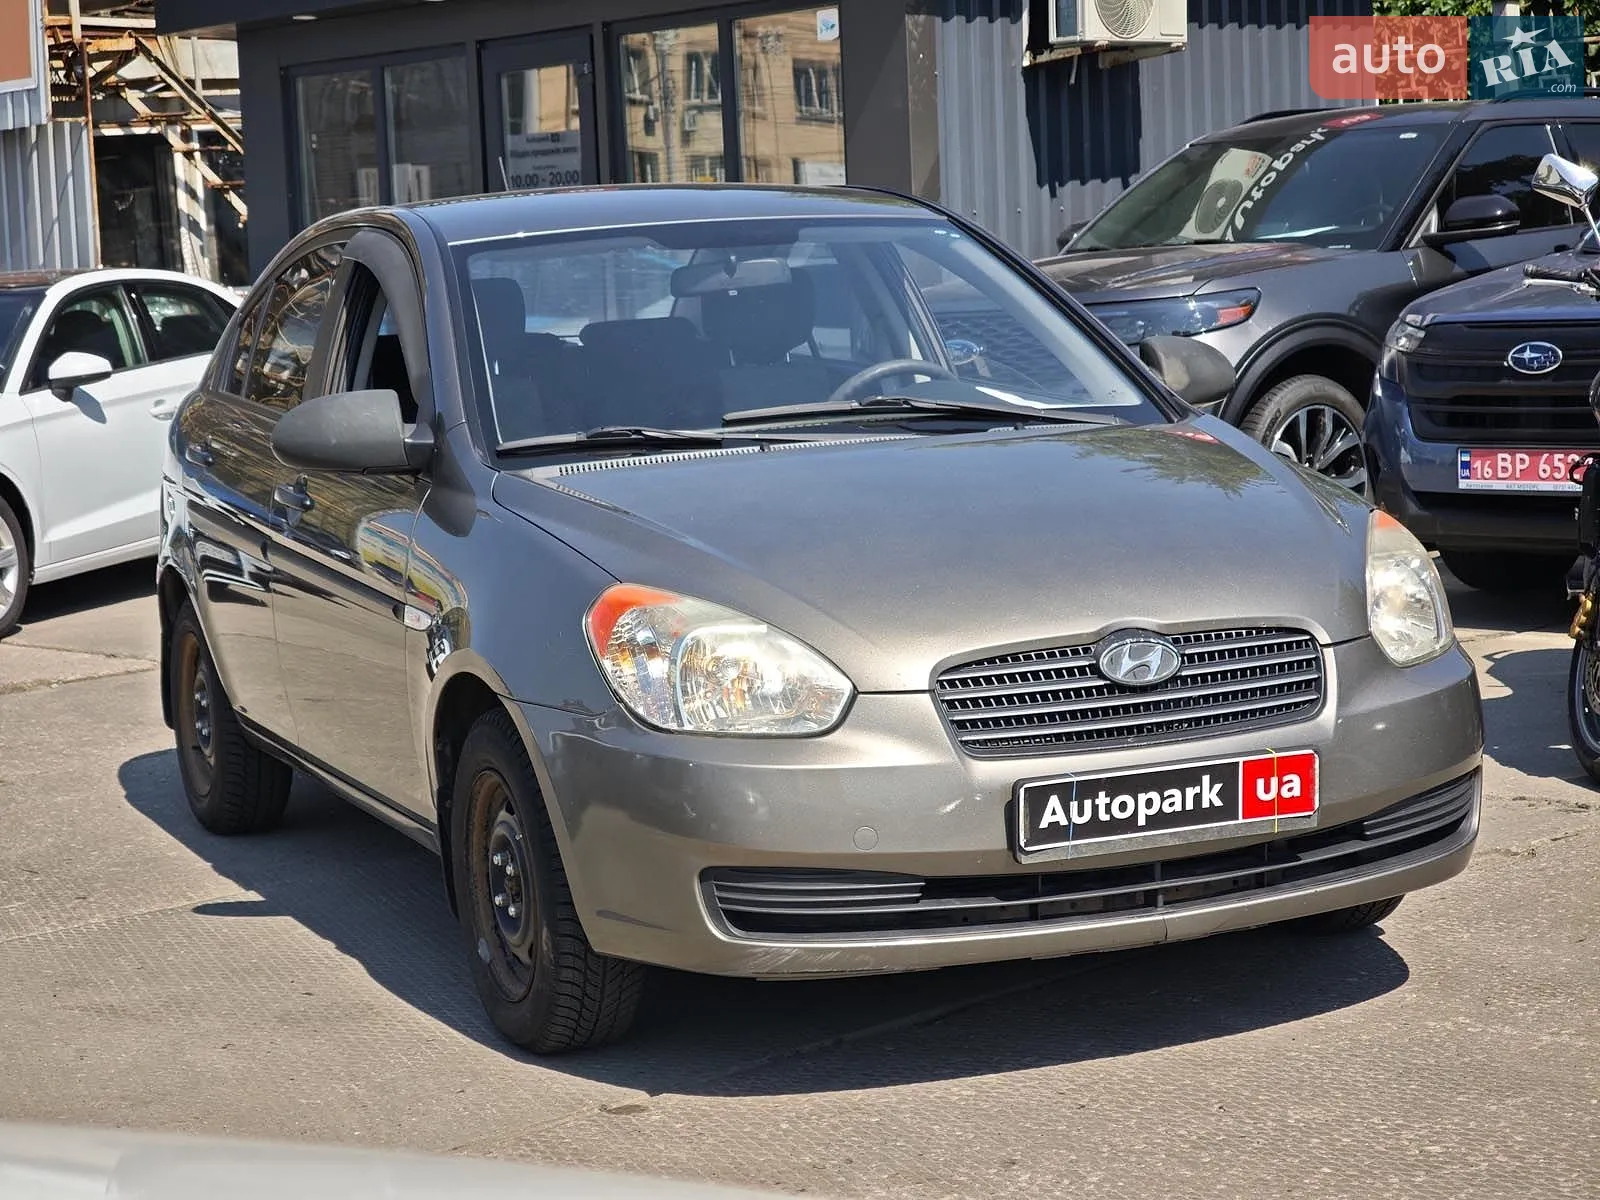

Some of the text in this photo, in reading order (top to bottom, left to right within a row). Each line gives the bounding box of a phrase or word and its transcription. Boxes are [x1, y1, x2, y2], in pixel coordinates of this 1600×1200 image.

[549, 170, 580, 186] 20.00
[1460, 468, 1470, 477] UA
[1473, 460, 1493, 481] 16
[1497, 453, 1530, 481] BP
[1038, 773, 1301, 829] Autopark ua
